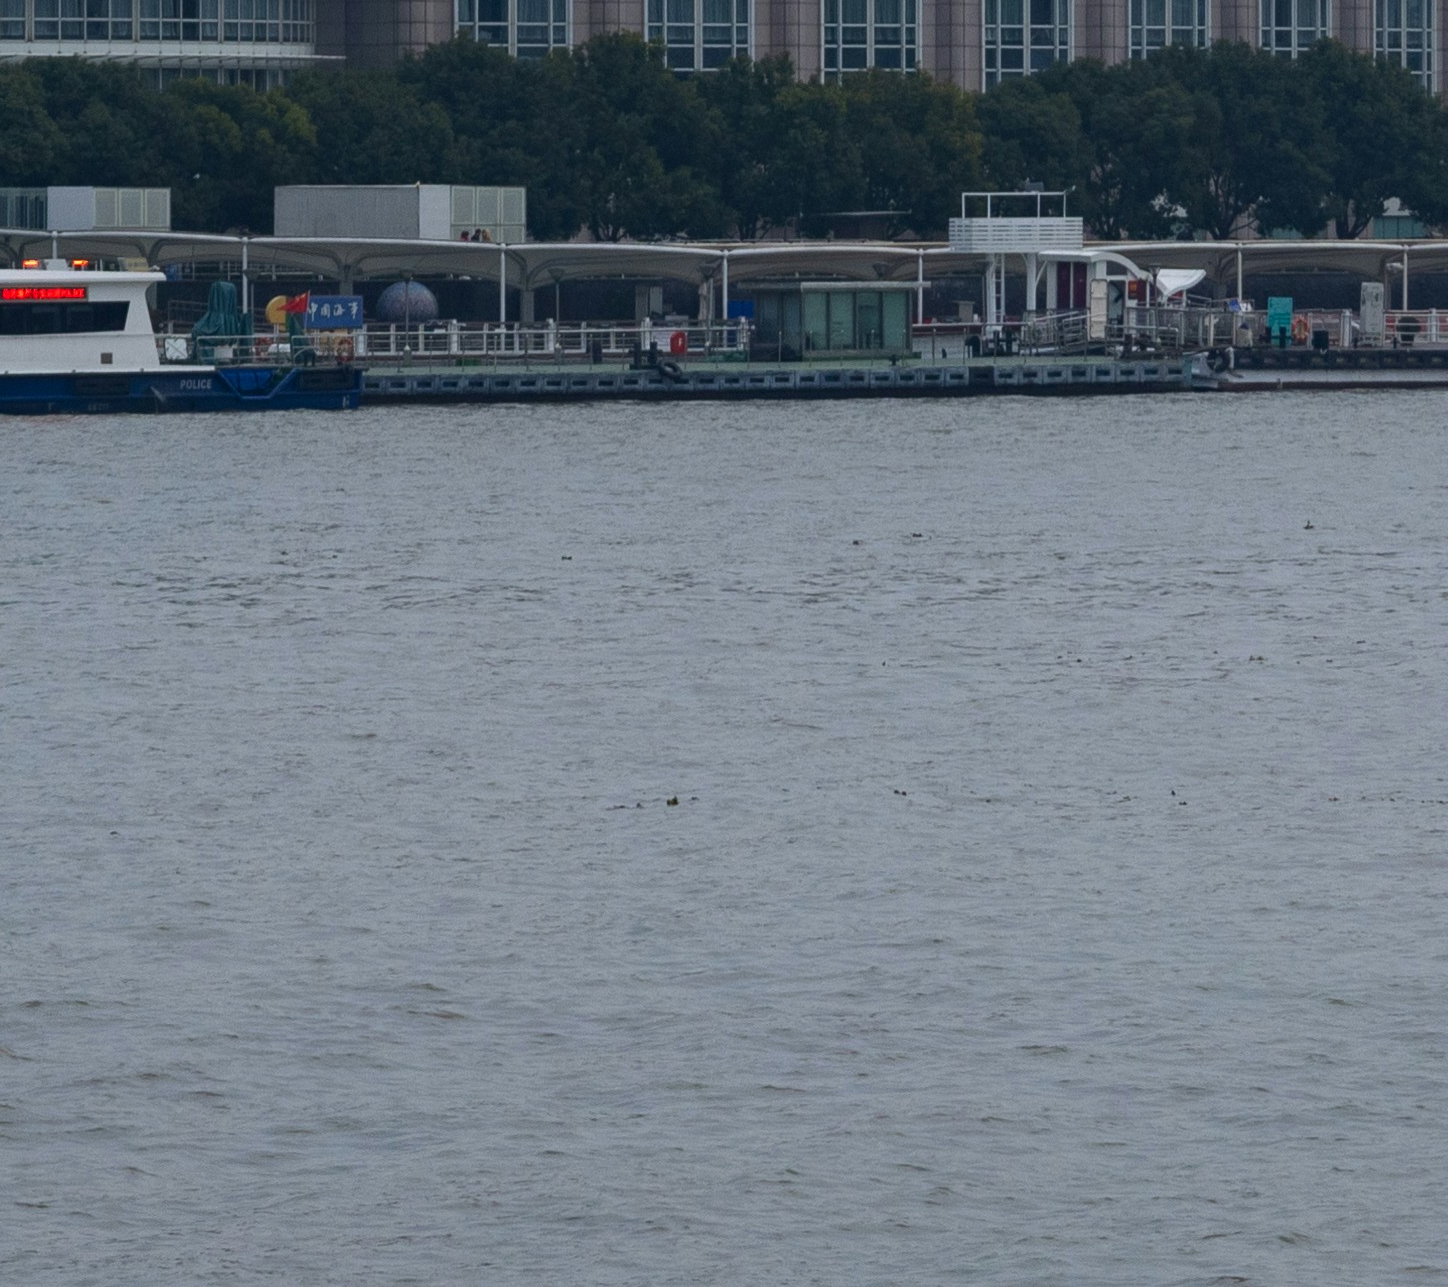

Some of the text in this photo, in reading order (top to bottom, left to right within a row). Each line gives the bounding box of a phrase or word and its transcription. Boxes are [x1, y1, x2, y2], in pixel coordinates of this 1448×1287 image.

[307, 301, 360, 322] 中国海事
[180, 378, 212, 390] POLICE
